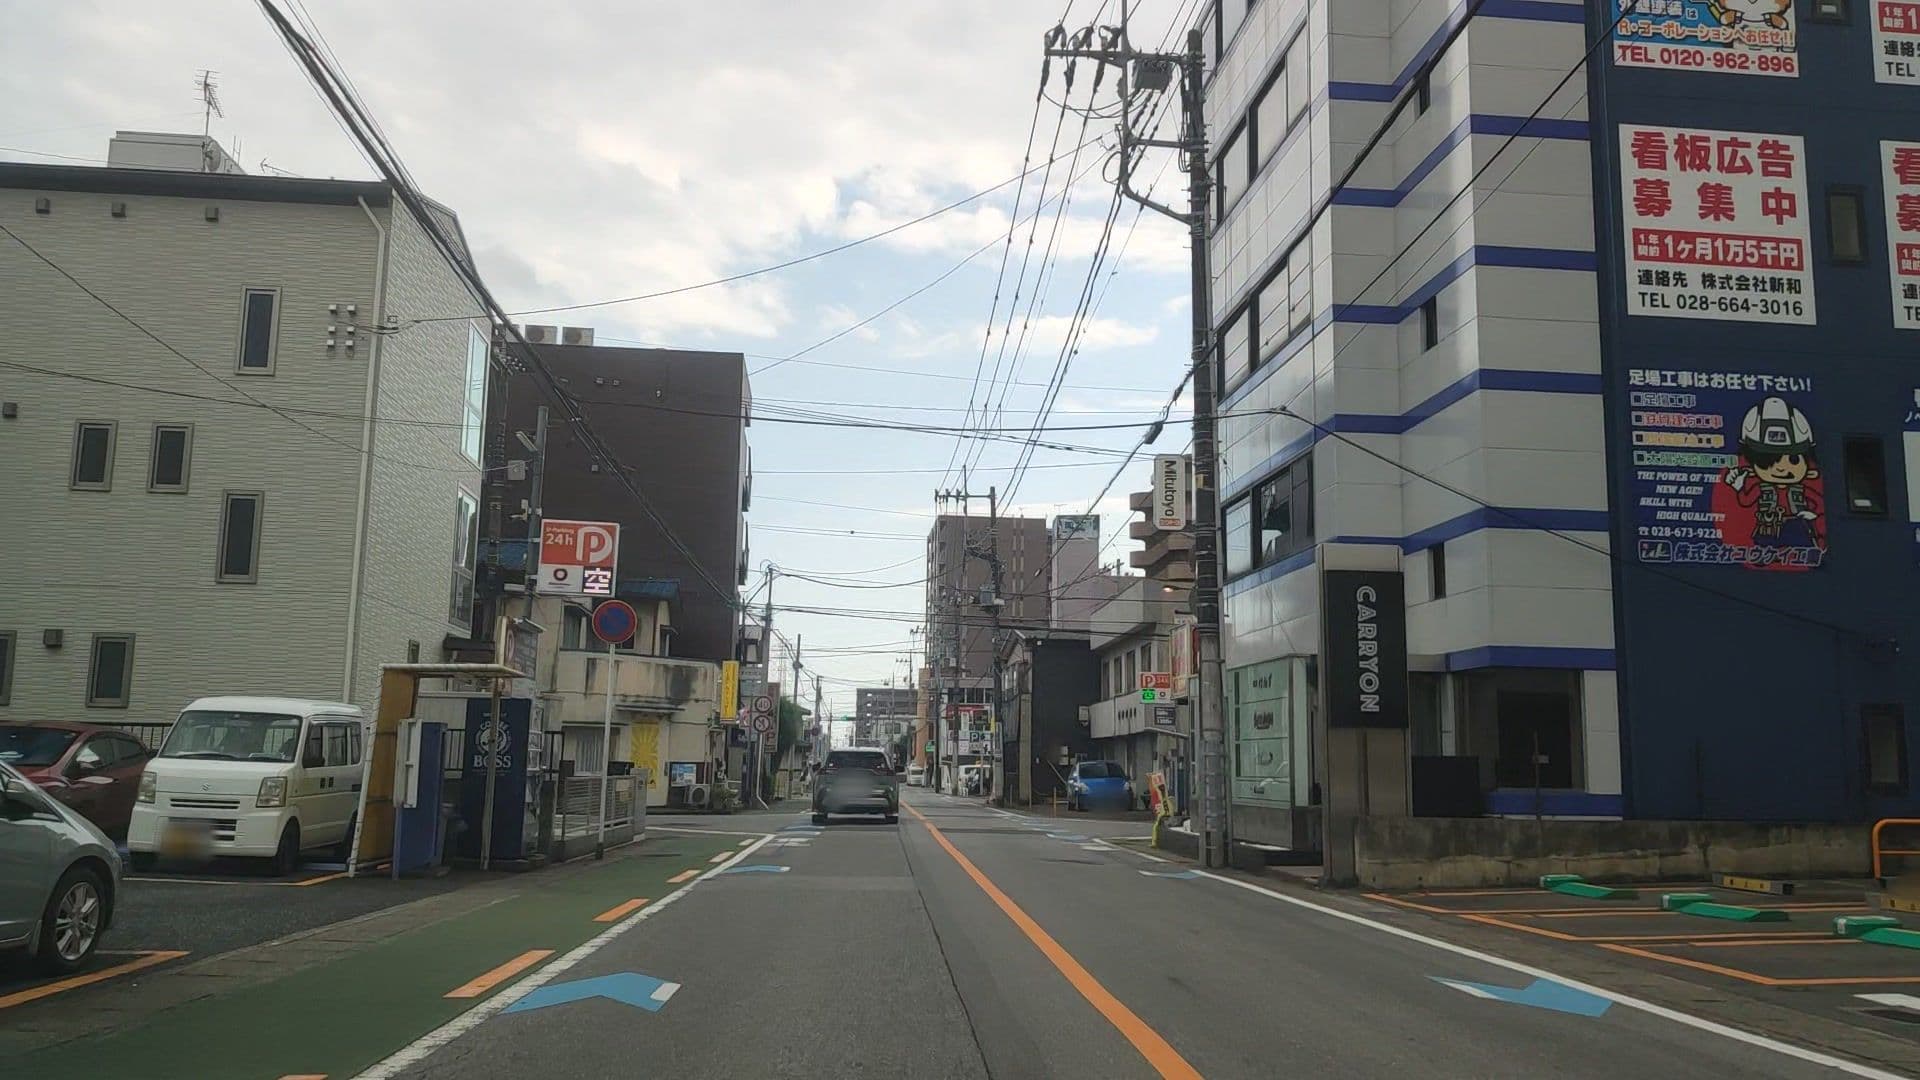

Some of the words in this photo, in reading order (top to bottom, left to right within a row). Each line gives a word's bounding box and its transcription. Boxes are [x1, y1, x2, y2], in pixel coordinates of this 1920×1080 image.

[1618, 45, 1656, 63] TEL
[1884, 40, 1920, 57] 連絡
[1885, 61, 1916, 78] TEL
[1631, 131, 1795, 179] 看板広告
[1638, 269, 1689, 288] 連絡先
[1701, 271, 1802, 295] 株式会社新和
[1638, 291, 1671, 308] TEL
[1676, 294, 1803, 316] 028-664-3016
[1160, 460, 1177, 517] Mitutoyo
[1637, 471, 1656, 481] THE
[1704, 474, 1722, 483] THE
[545, 532, 574, 546] 24h
[1651, 526, 1723, 539] 028-673-9228
[1674, 542, 1823, 567] 株式会社ユウケイ工
[583, 567, 612, 594] 空
[1356, 585, 1380, 712] CARRYON
